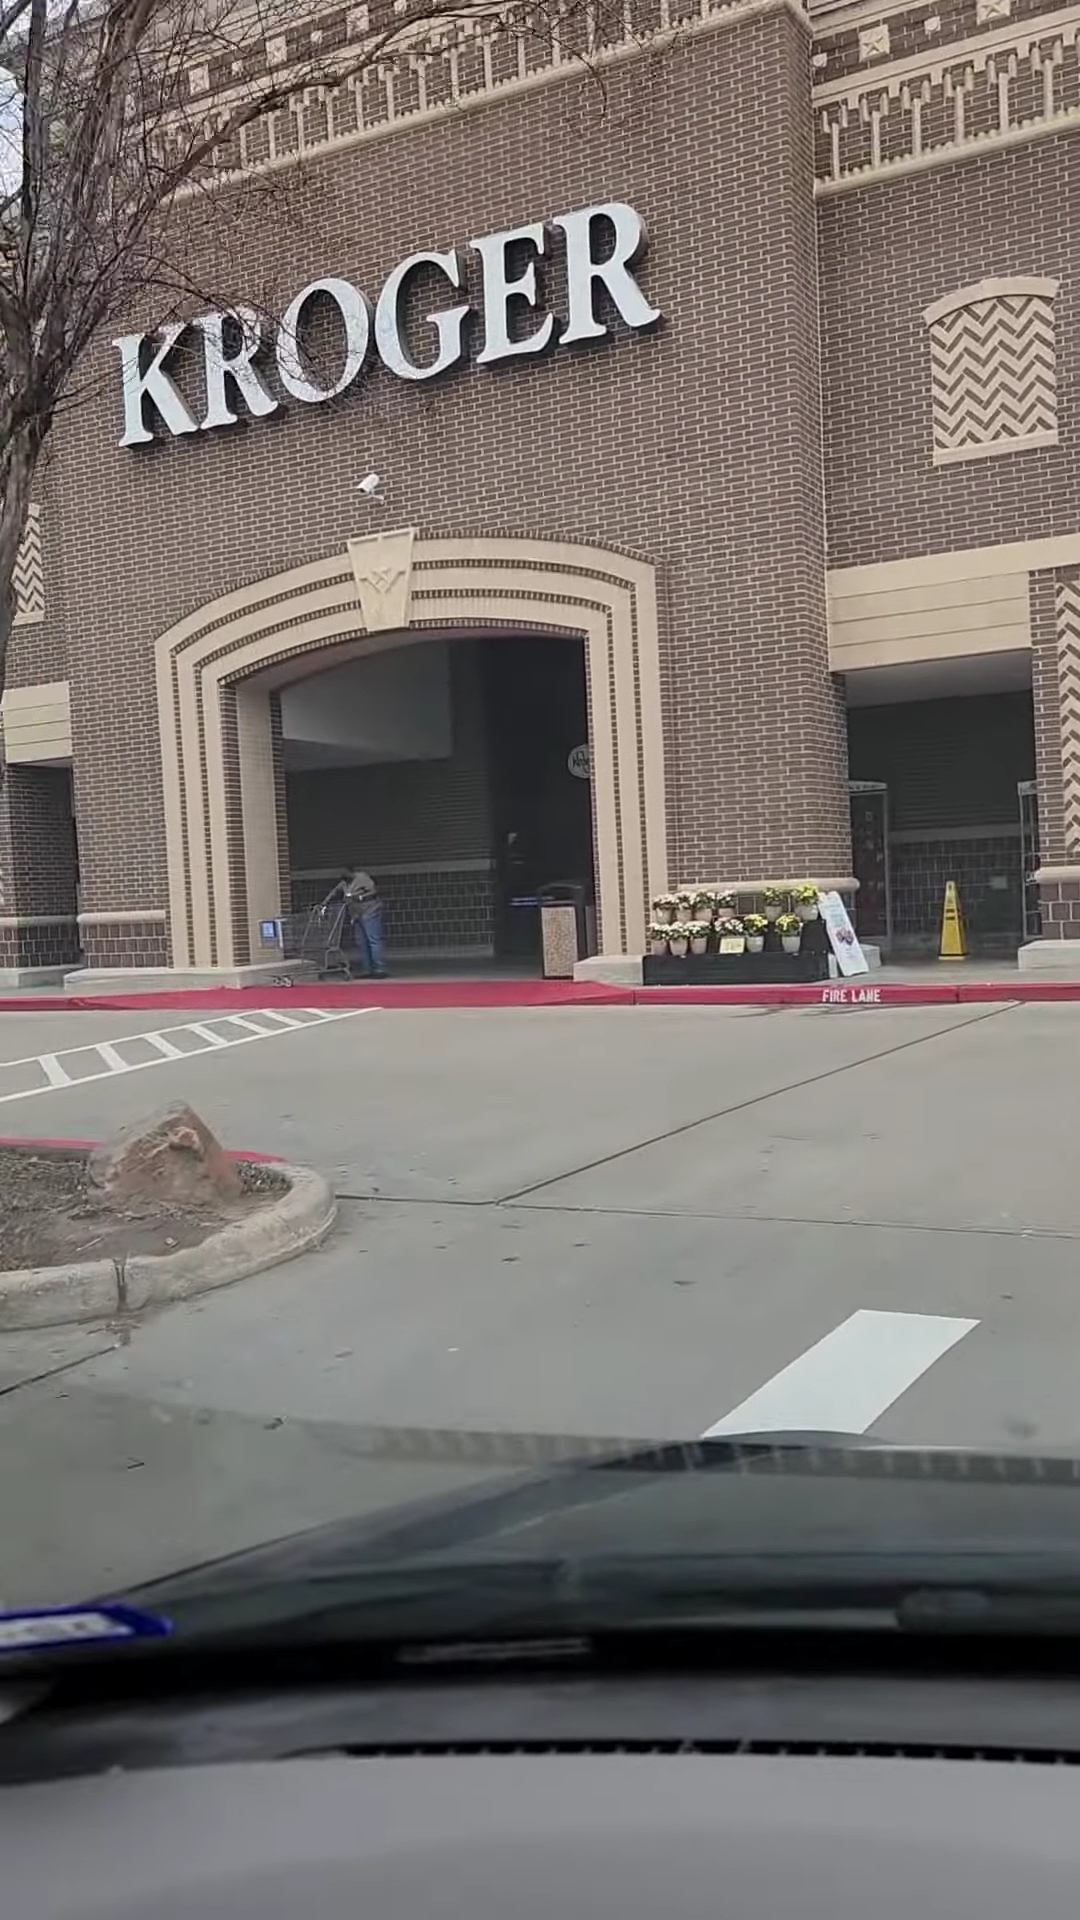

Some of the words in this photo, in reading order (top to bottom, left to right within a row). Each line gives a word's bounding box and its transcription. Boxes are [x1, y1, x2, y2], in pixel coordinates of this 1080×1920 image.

[112, 203, 661, 447] KROGER
[822, 989, 848, 1002] FIRE
[851, 989, 881, 1002] LANE
